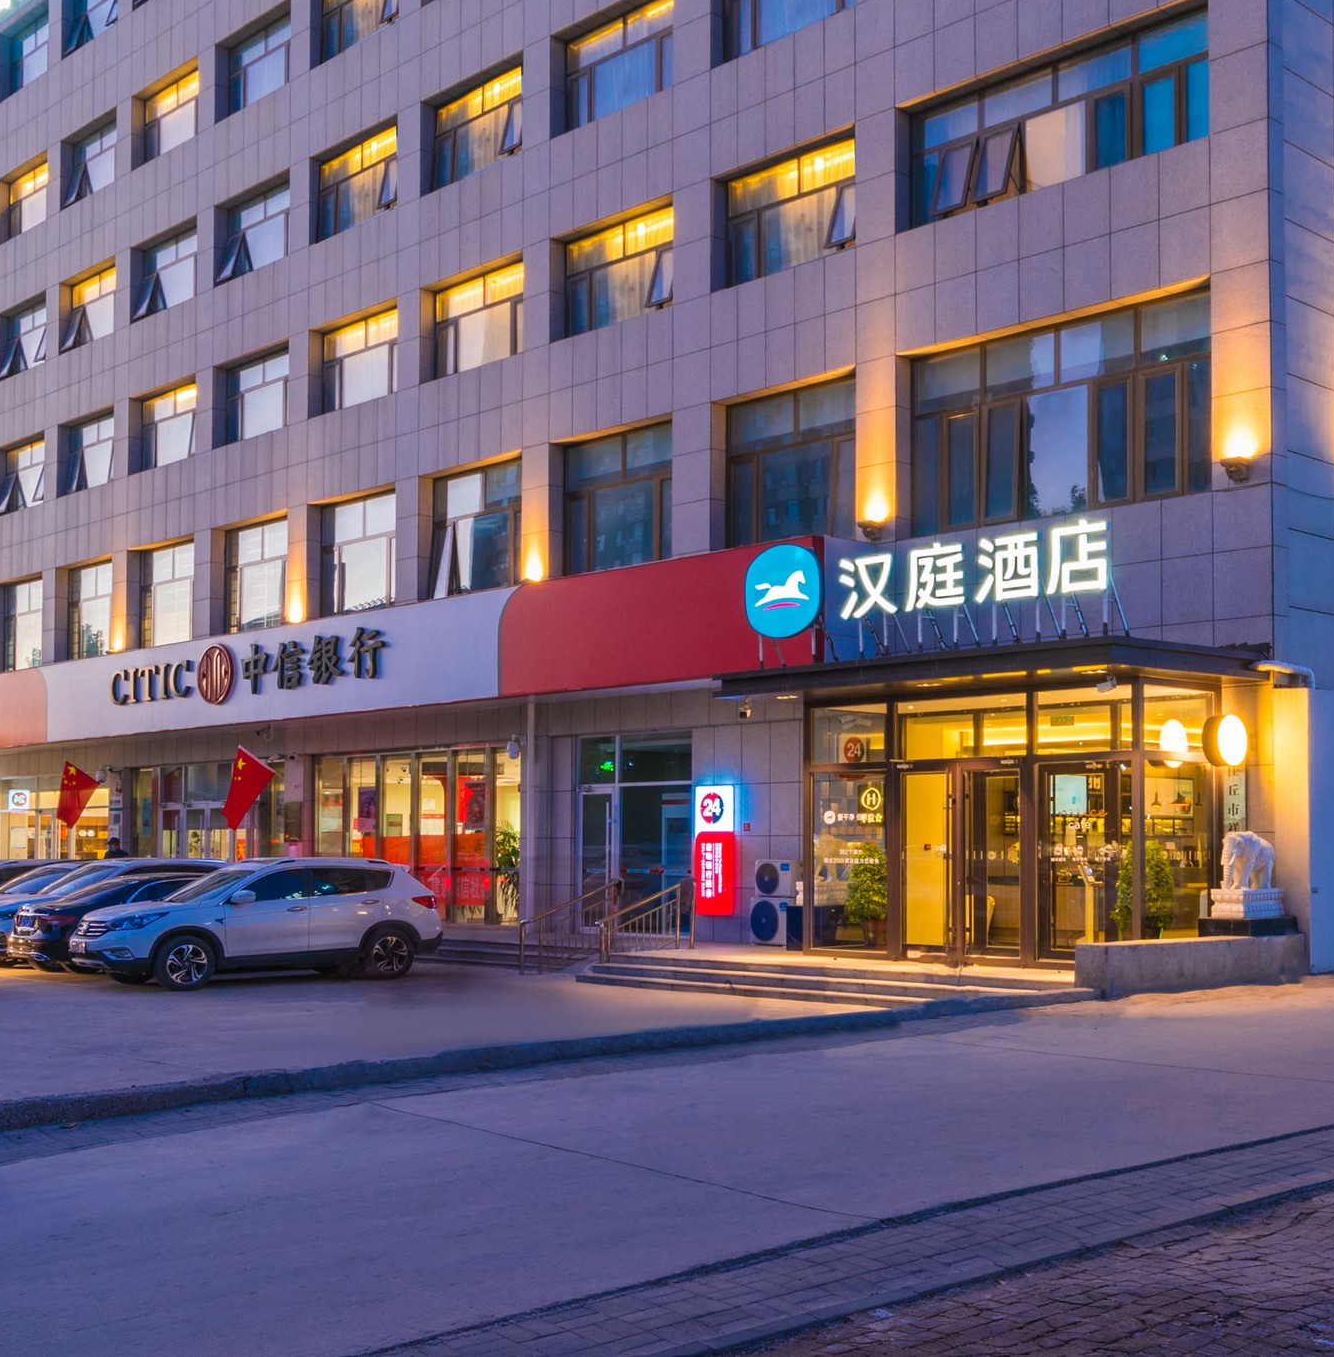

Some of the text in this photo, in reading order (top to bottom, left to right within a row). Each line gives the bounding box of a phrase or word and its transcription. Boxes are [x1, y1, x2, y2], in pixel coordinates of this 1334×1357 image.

[839, 519, 1108, 621] 汉庭酒店
[110, 659, 195, 706] CITIC
[240, 626, 387, 695] 中信银行
[846, 743, 862, 757] 24
[702, 797, 722, 817] 24
